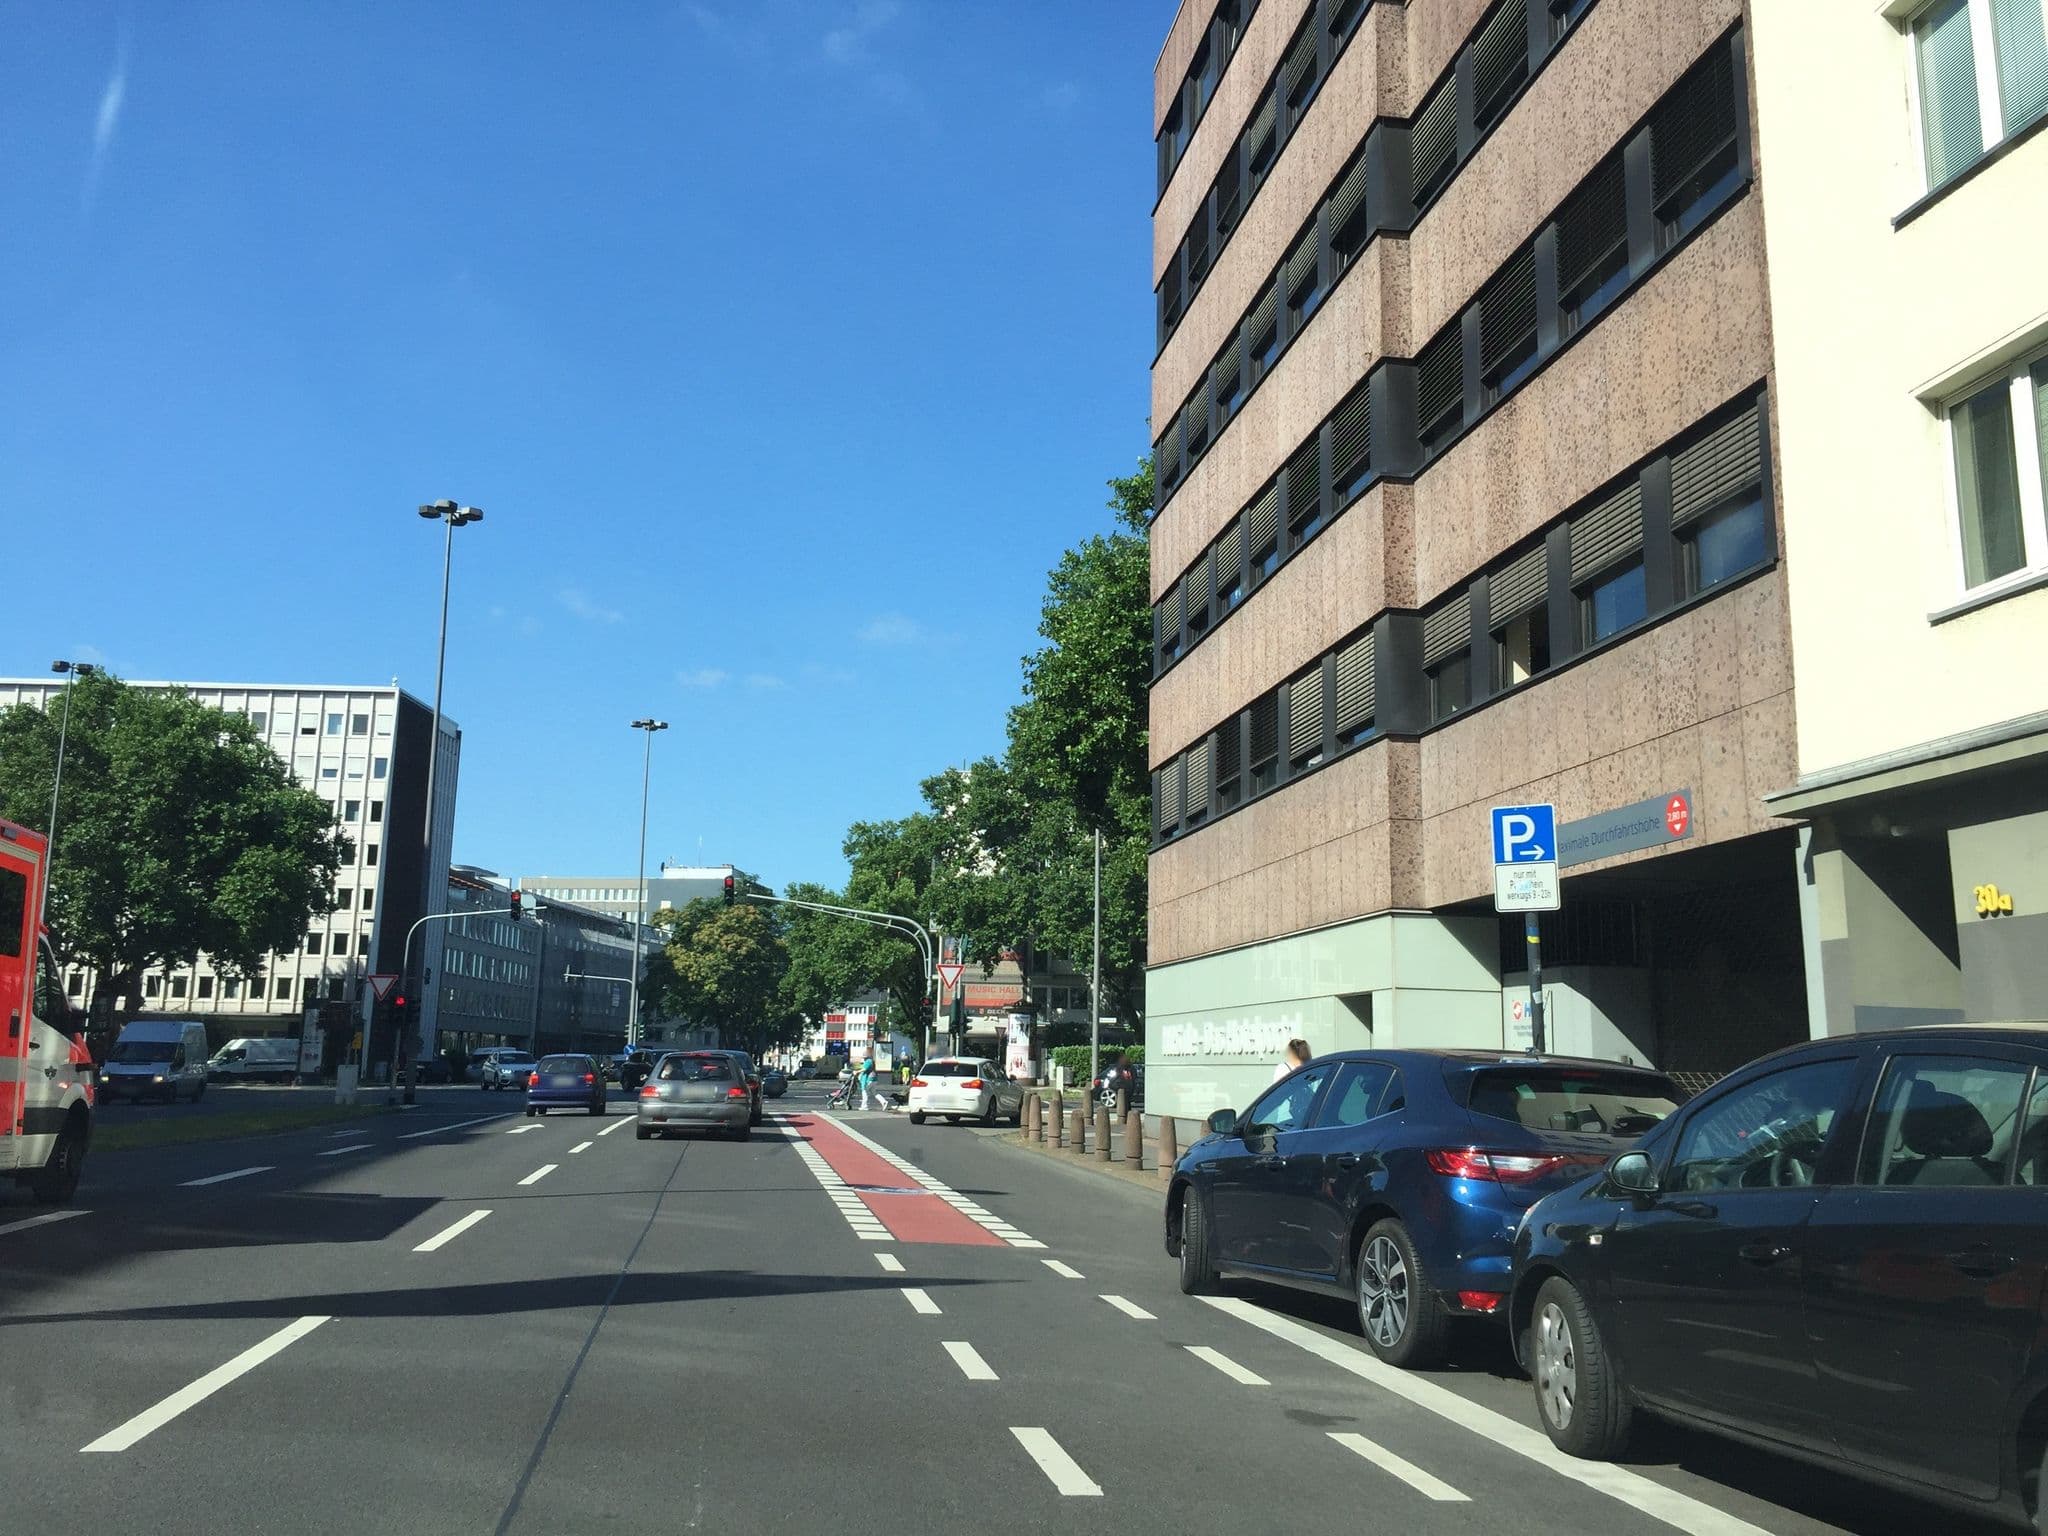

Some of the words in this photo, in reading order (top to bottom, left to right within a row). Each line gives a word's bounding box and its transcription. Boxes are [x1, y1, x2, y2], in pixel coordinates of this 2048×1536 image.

[1502, 814, 1535, 861] P
[1557, 835, 1589, 853] aximale
[1973, 883, 2013, 913] 30a
[967, 985, 997, 993] MUSIC
[999, 985, 1020, 993] HALL
